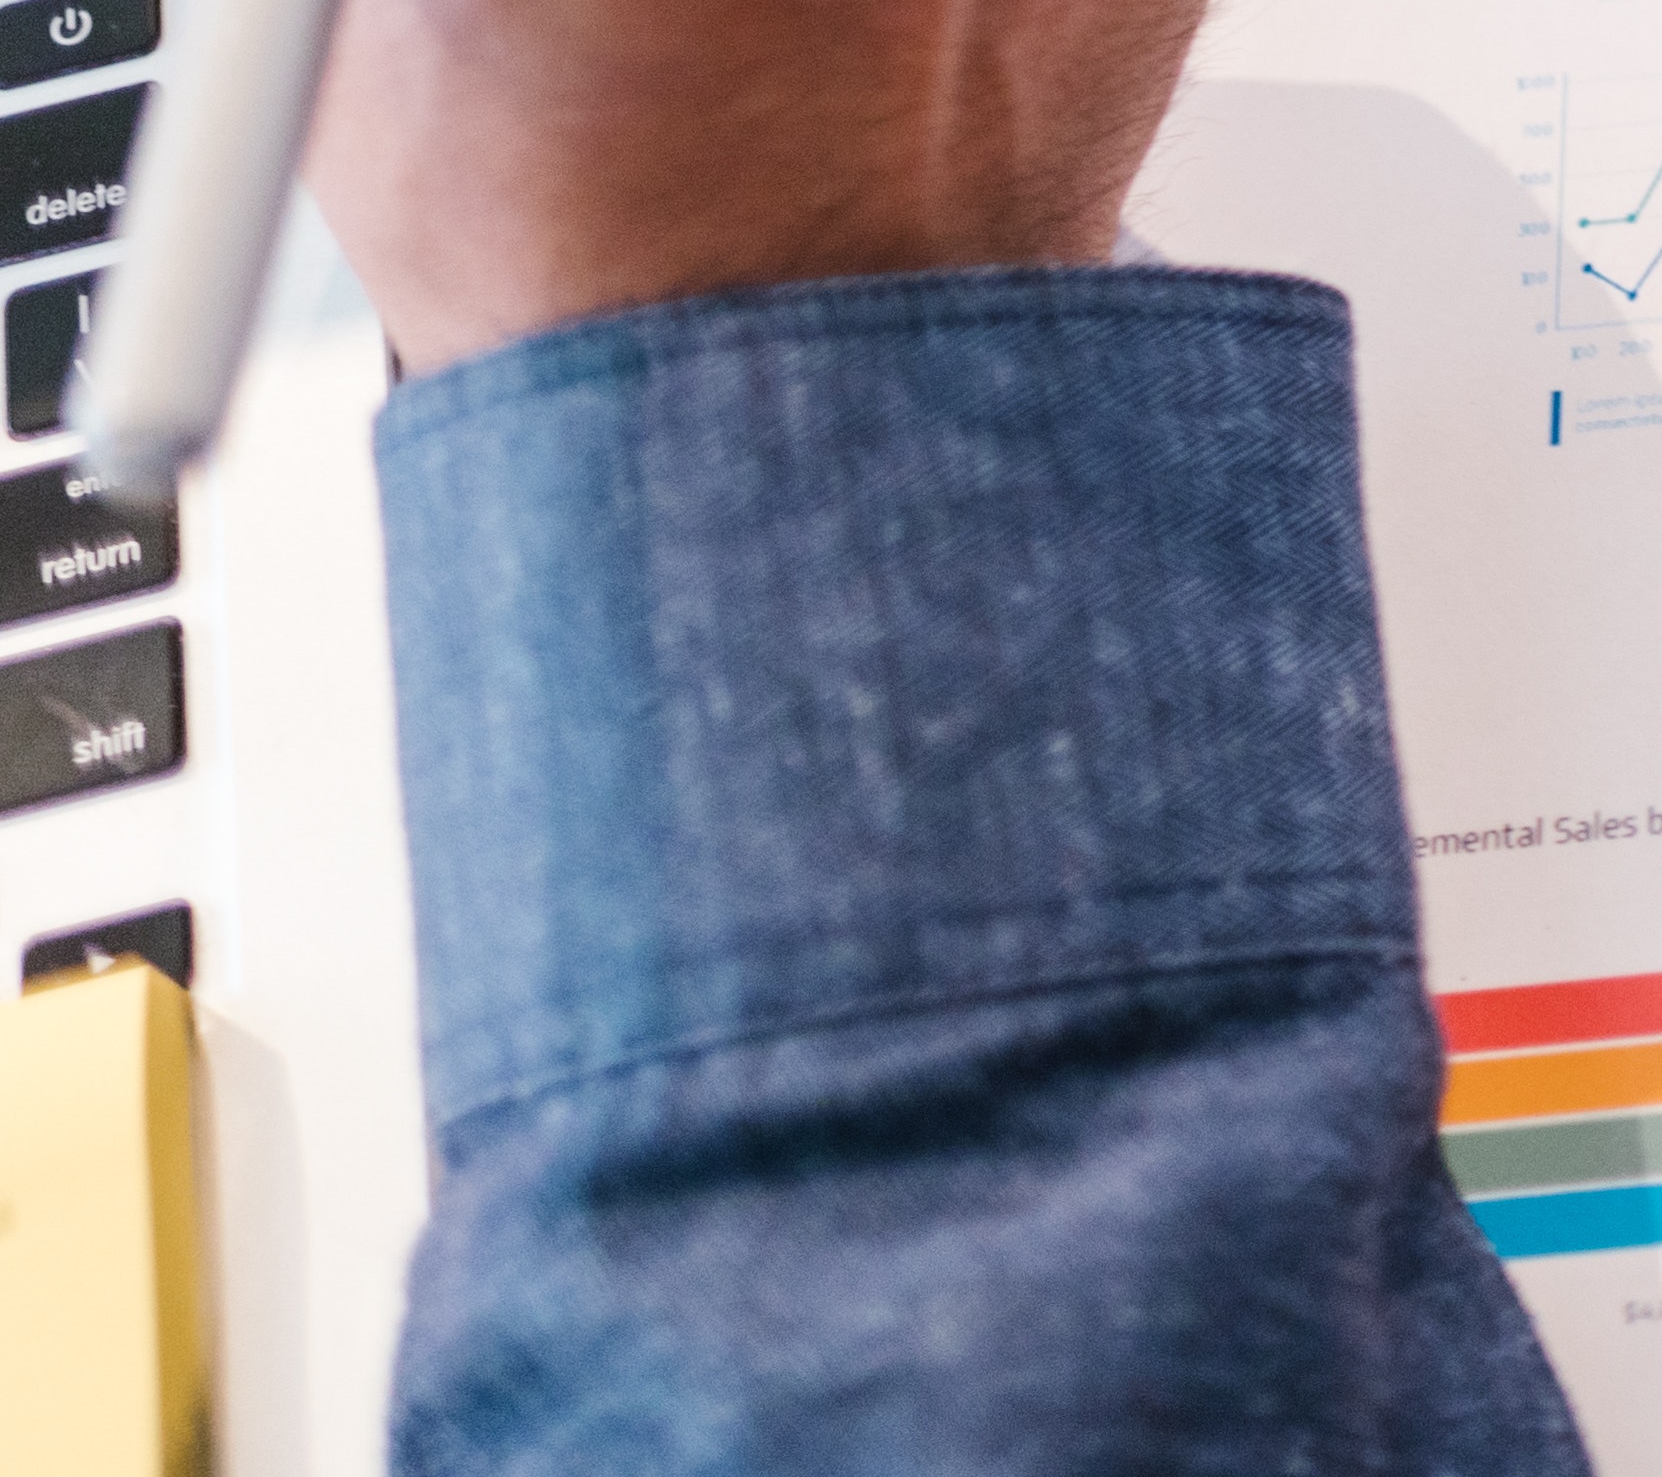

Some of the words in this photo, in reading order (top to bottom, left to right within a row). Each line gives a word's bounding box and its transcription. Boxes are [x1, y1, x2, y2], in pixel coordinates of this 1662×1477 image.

[27, 180, 129, 229] delete
[42, 540, 140, 583] return
[74, 721, 144, 763] shift
[1414, 817, 1543, 858] emental
[1554, 805, 1638, 845] Sales
